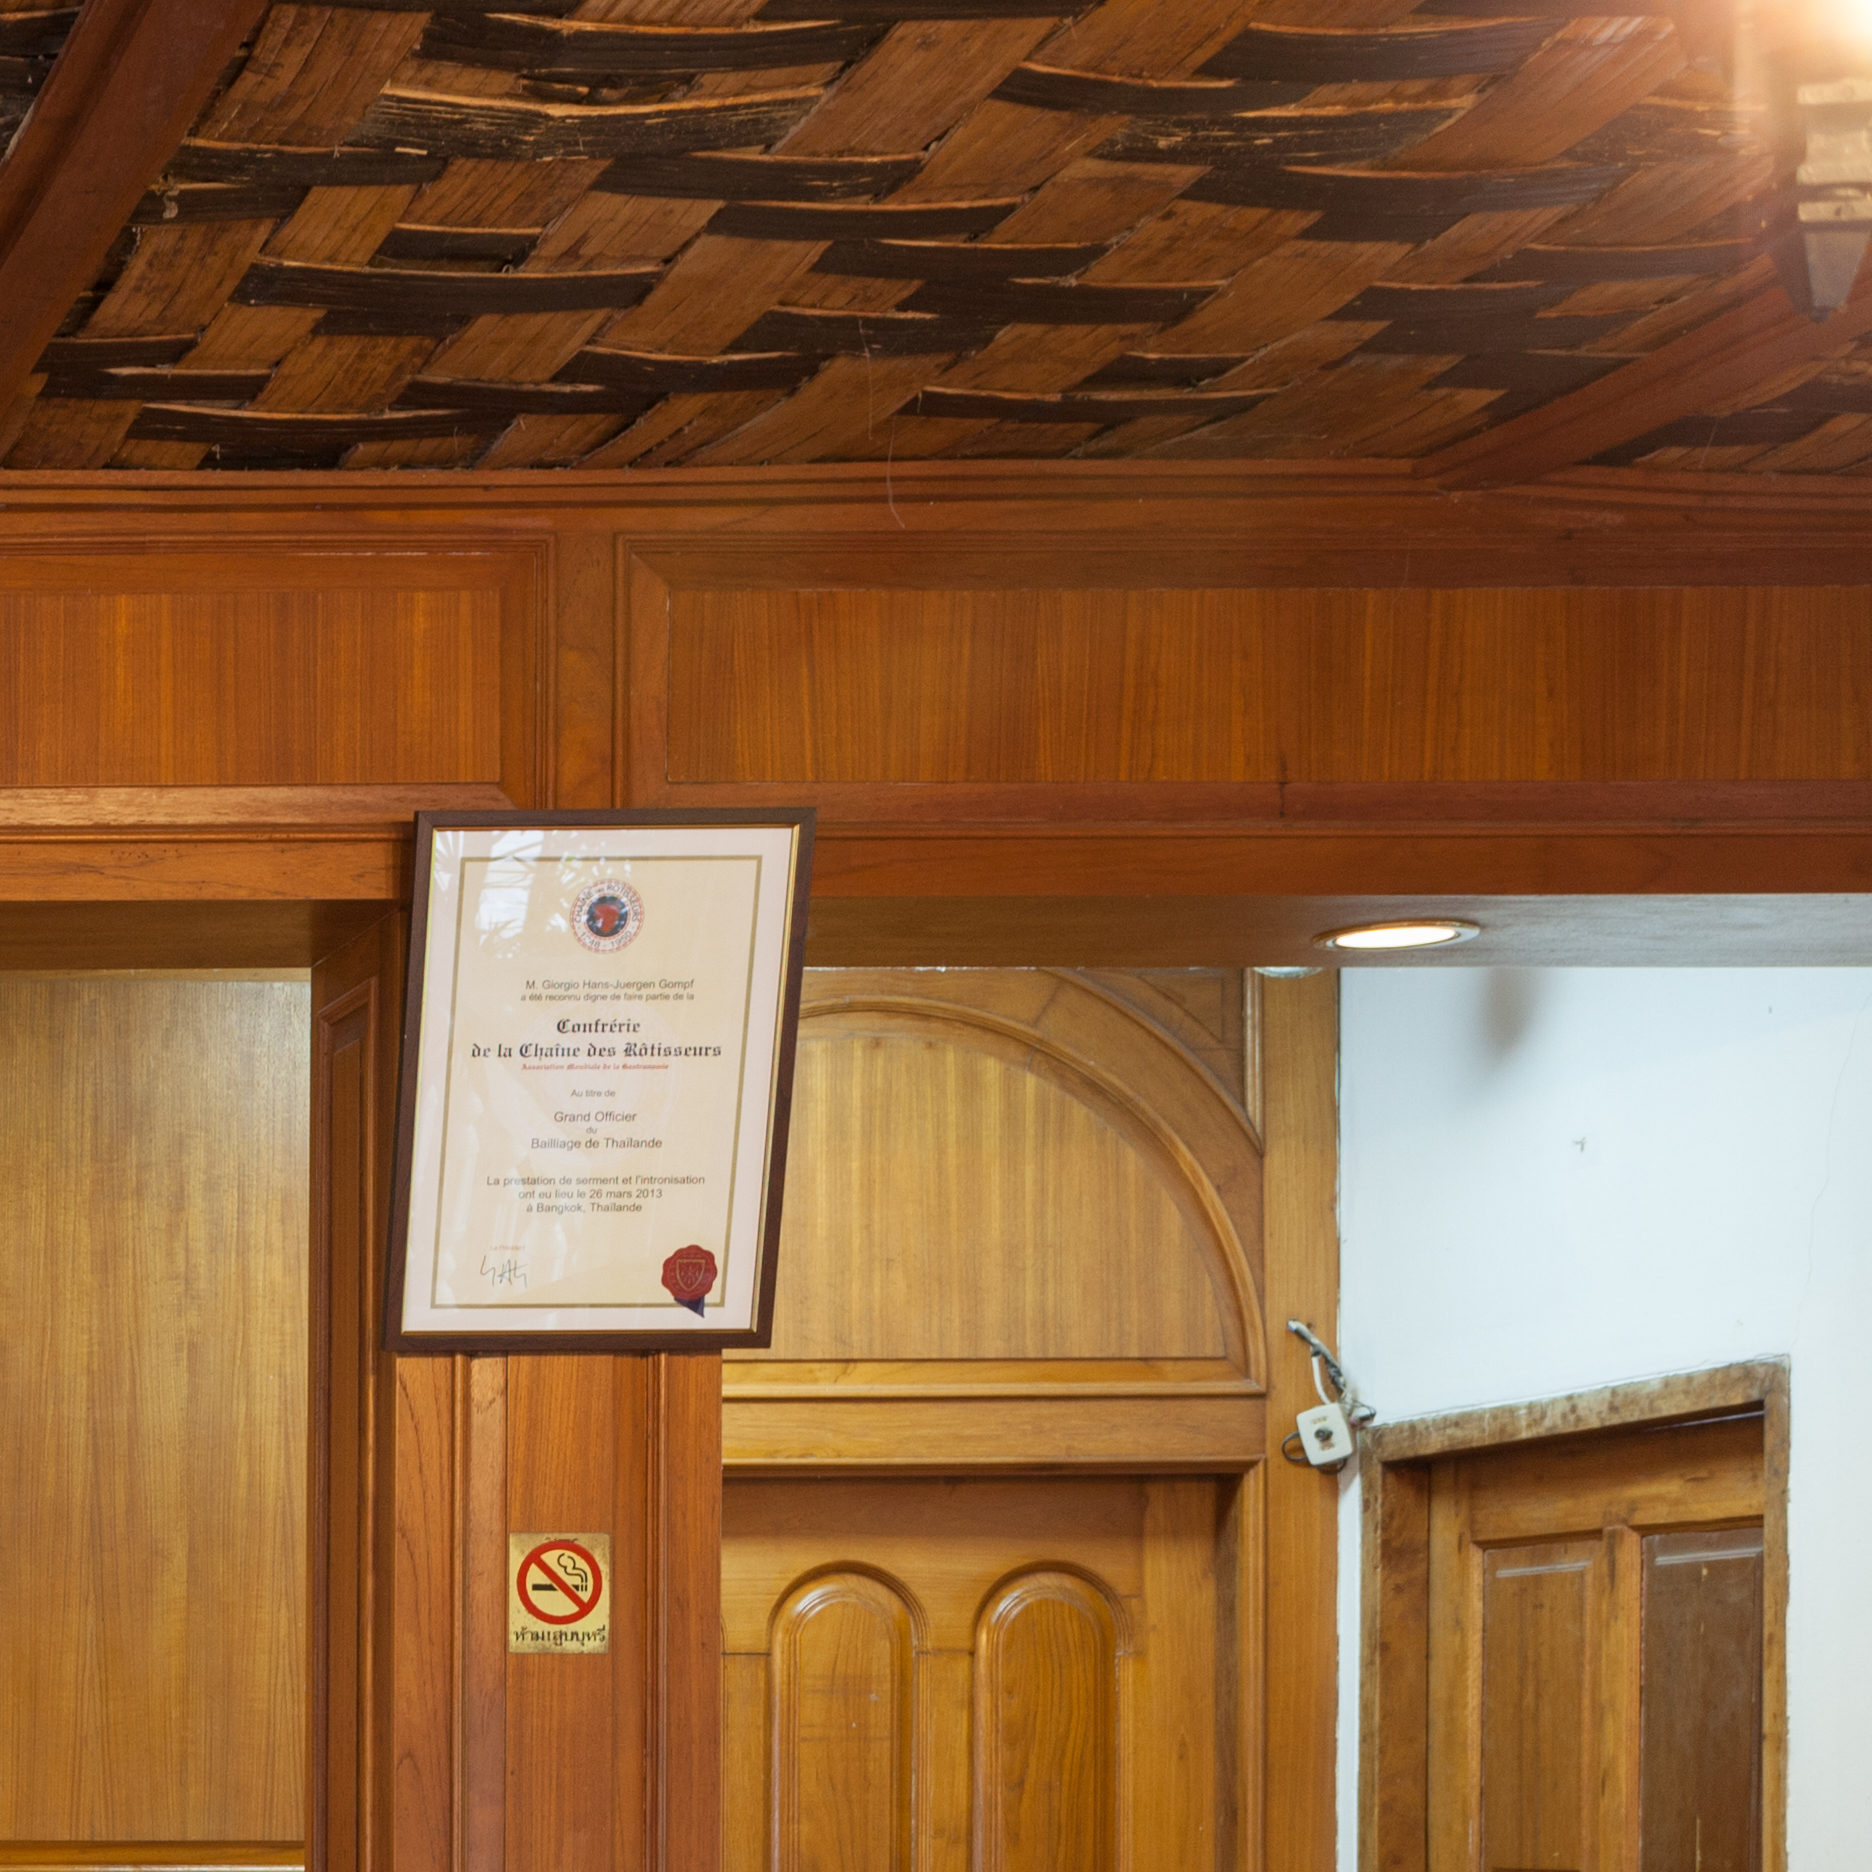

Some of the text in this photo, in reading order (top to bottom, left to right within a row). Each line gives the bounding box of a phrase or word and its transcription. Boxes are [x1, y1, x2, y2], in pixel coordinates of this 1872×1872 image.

[526, 979, 694, 991] M. Giorgio Hans-Juergen Gompf
[557, 1018, 641, 1034] Confrérie
[471, 1042, 722, 1061] de la Chaîne des Rôtisseurs
[554, 1111, 637, 1122] Grand Officier
[531, 1137, 662, 1151] Bailliage de Thaïlande
[487, 1175, 705, 1187] La prestation de serment et l'intronisation
[519, 1189, 663, 1199] ont eu lieu le 26 mars 2013
[527, 1202, 642, 1214] à Bangkok, Thaïlande
